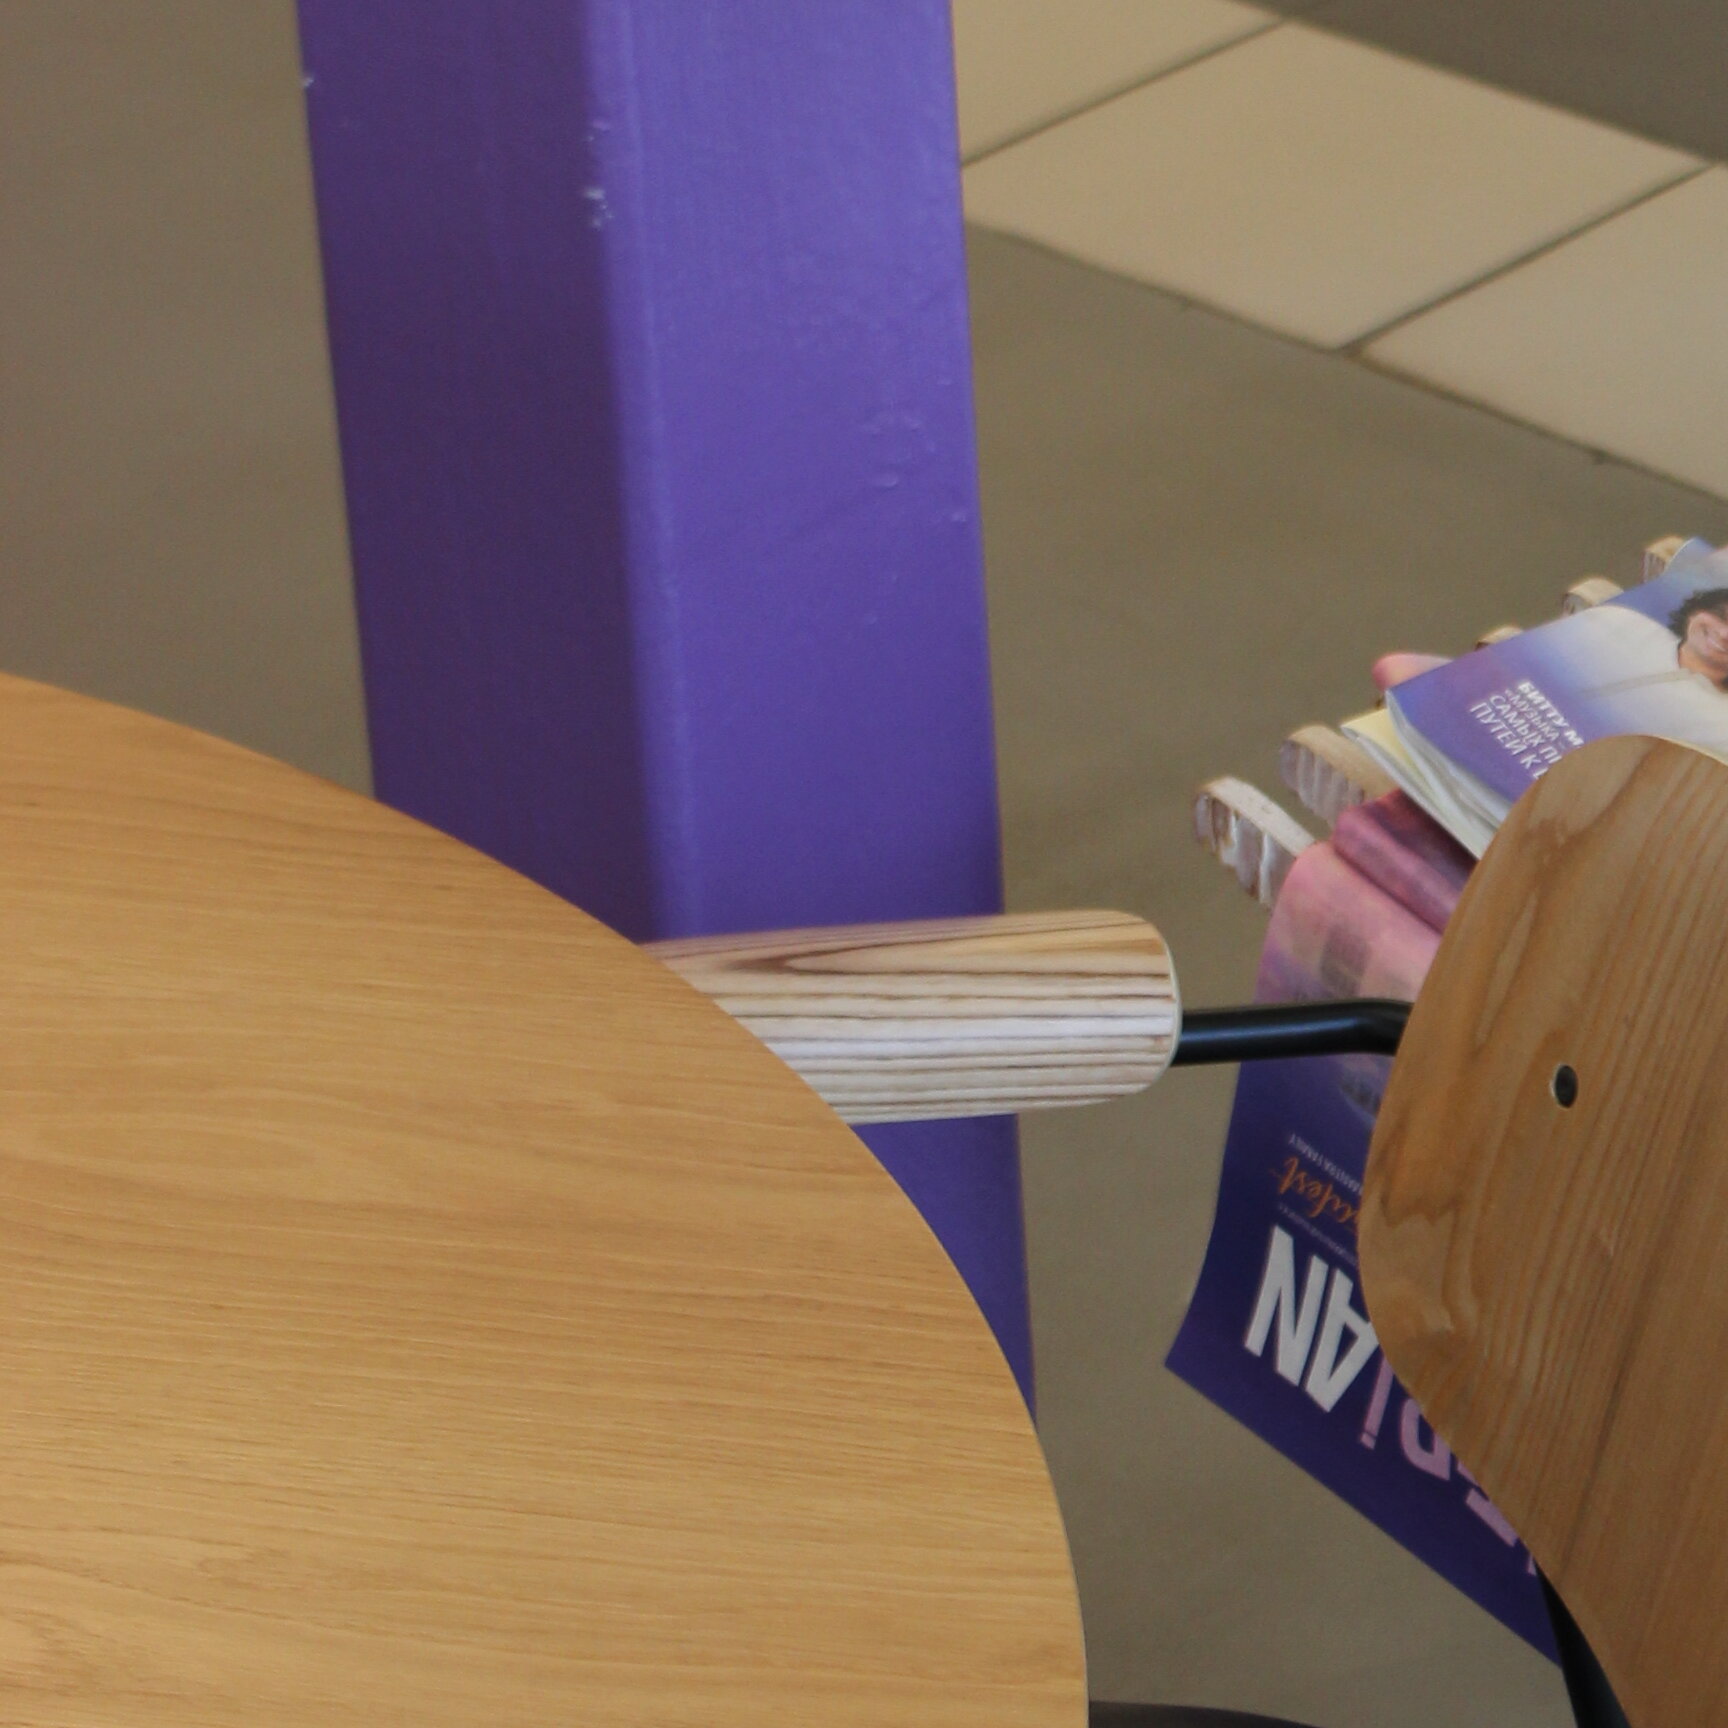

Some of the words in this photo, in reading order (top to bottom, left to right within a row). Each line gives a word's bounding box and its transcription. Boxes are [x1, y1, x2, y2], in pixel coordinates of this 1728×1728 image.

[1469, 702, 1530, 755] ПУТЕЙ
[1490, 695, 1546, 747] САМЫХ
[1518, 681, 1570, 727] БИТТУ
